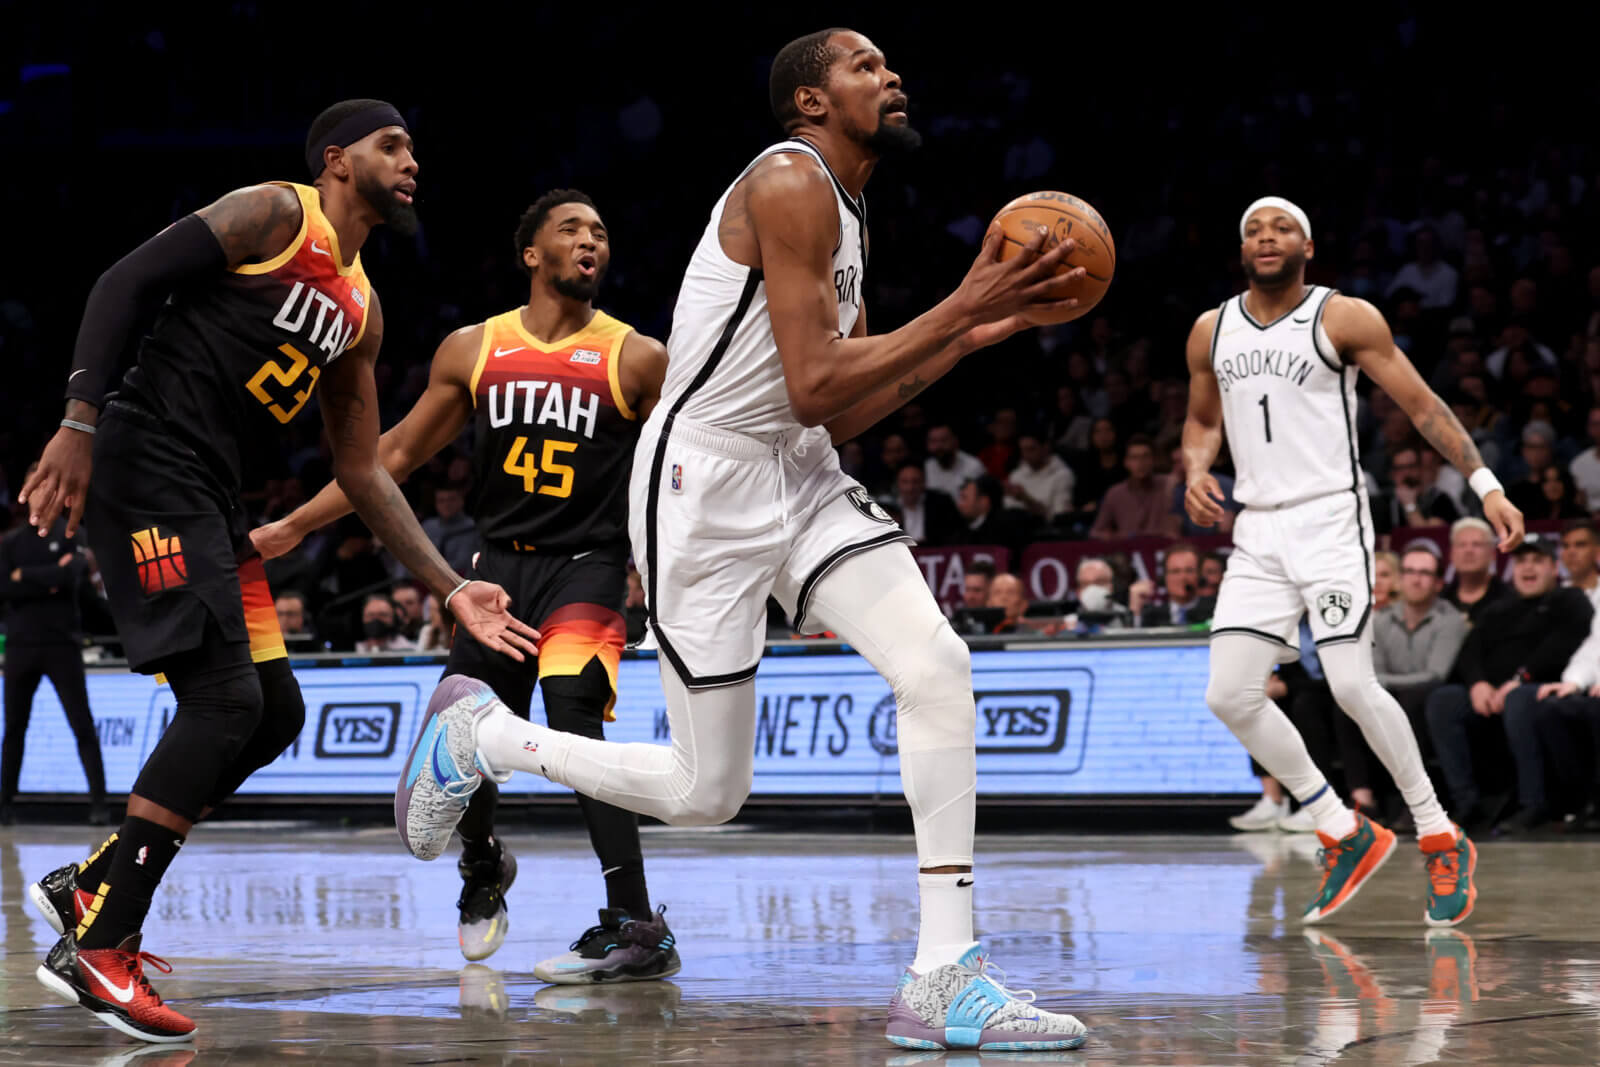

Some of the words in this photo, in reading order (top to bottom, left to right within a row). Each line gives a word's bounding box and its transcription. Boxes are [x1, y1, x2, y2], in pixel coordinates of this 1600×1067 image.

[1216, 349, 1314, 393] BROOKLYN
[488, 380, 600, 439] UTAH
[1258, 394, 1272, 443] 1
[503, 436, 578, 498] 45
[333, 717, 385, 743] YES
[754, 693, 854, 757] NETS
[983, 706, 1051, 737] YES
